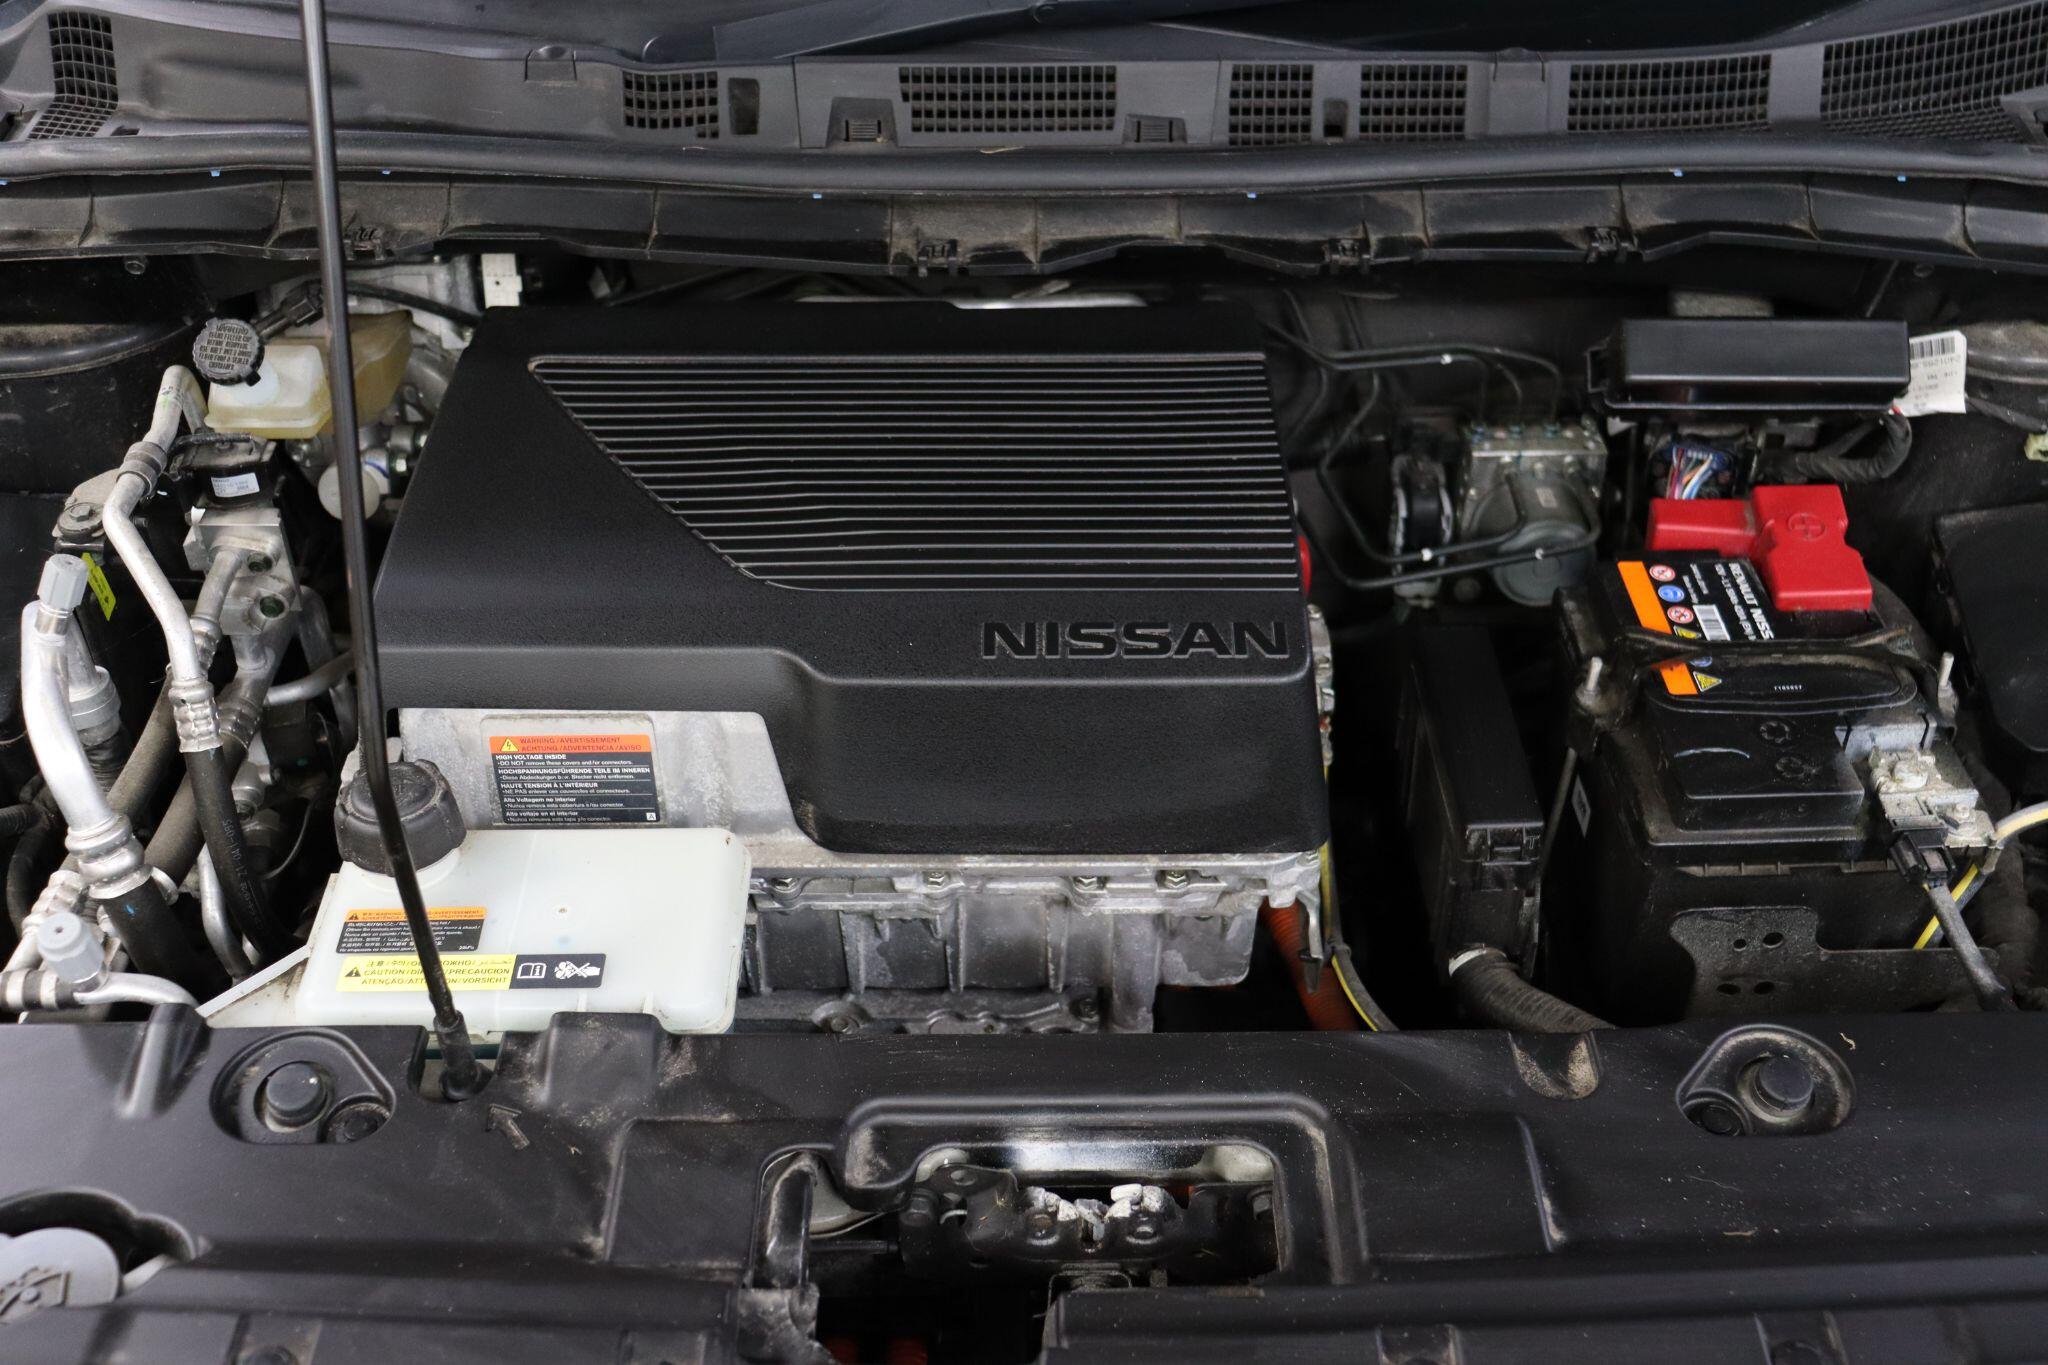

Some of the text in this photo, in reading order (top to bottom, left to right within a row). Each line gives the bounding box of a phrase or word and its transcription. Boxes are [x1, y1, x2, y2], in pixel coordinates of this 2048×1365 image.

[1729, 562, 1775, 640] RENAULT NISS
[982, 621, 1290, 659] NISSAN
